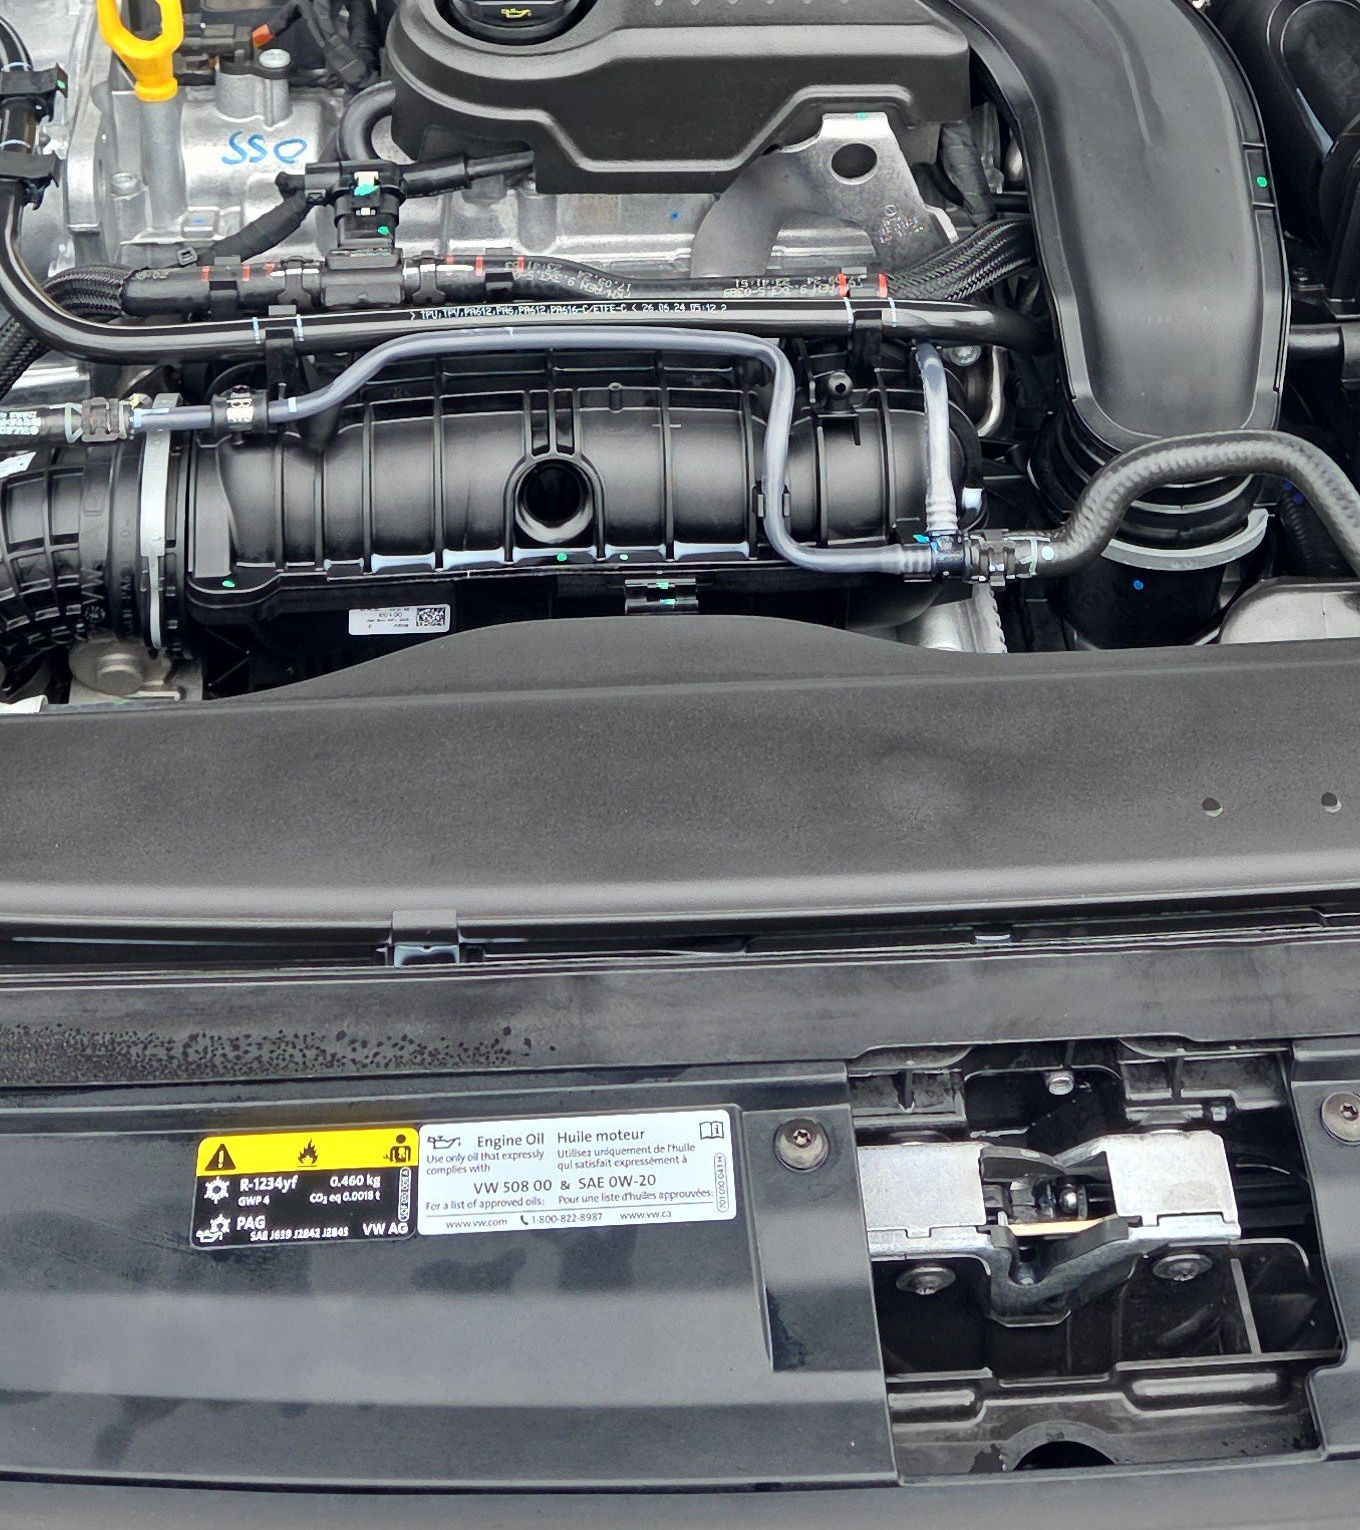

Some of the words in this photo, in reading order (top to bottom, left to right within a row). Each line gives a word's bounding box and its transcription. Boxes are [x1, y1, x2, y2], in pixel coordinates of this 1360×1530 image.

[477, 1135, 522, 1150] Engine
[526, 1132, 544, 1146] Oil
[557, 1130, 592, 1144] Huile
[596, 1128, 645, 1142] moteur
[426, 1154, 444, 1164] Use
[445, 1153, 466, 1165] only
[467, 1153, 479, 1162] oil
[480, 1152, 500, 1161] that
[501, 1149, 544, 1162] expressly
[557, 1148, 592, 1158] Utilisez
[594, 1145, 651, 1159] uniquement
[653, 1144, 666, 1154] de
[667, 1142, 696, 1153] l'huile
[426, 1165, 467, 1177] complies
[469, 1164, 491, 1173] with
[557, 1160, 573, 1172] qui
[574, 1158, 612, 1169] satisfait
[614, 1156, 680, 1169] expressément
[239, 1174, 299, 1194] R-1234yf
[330, 1174, 363, 1188] 0.460
[366, 1173, 381, 1190] kg
[473, 1181, 499, 1194] VW
[503, 1180, 529, 1193] 508
[533, 1179, 552, 1192] 00
[560, 1180, 571, 1191] &
[578, 1176, 605, 1190] SAE
[609, 1174, 657, 1188] 0W-20
[238, 1196, 263, 1206] GWP
[329, 1194, 341, 1204] eq
[342, 1190, 374, 1202] 0.0018
[426, 1201, 440, 1211] For
[450, 1200, 465, 1210] list
[466, 1199, 477, 1209] of
[479, 1197, 524, 1210] approved
[525, 1196, 545, 1206] oils:
[558, 1193, 579, 1204] Pour
[581, 1193, 600, 1203] une
[601, 1191, 620, 1202] liste
[621, 1190, 657, 1202] d'huiles
[658, 1187, 714, 1201] approuvées:
[236, 1215, 266, 1230] PAG
[446, 1218, 508, 1229] www.vw.com
[531, 1212, 603, 1225] 1-800-822-8987
[620, 1210, 672, 1221] www.vw.ca
[250, 1230, 269, 1241] SAE
[362, 1222, 386, 1237] VW
[388, 1222, 409, 1236] AG
